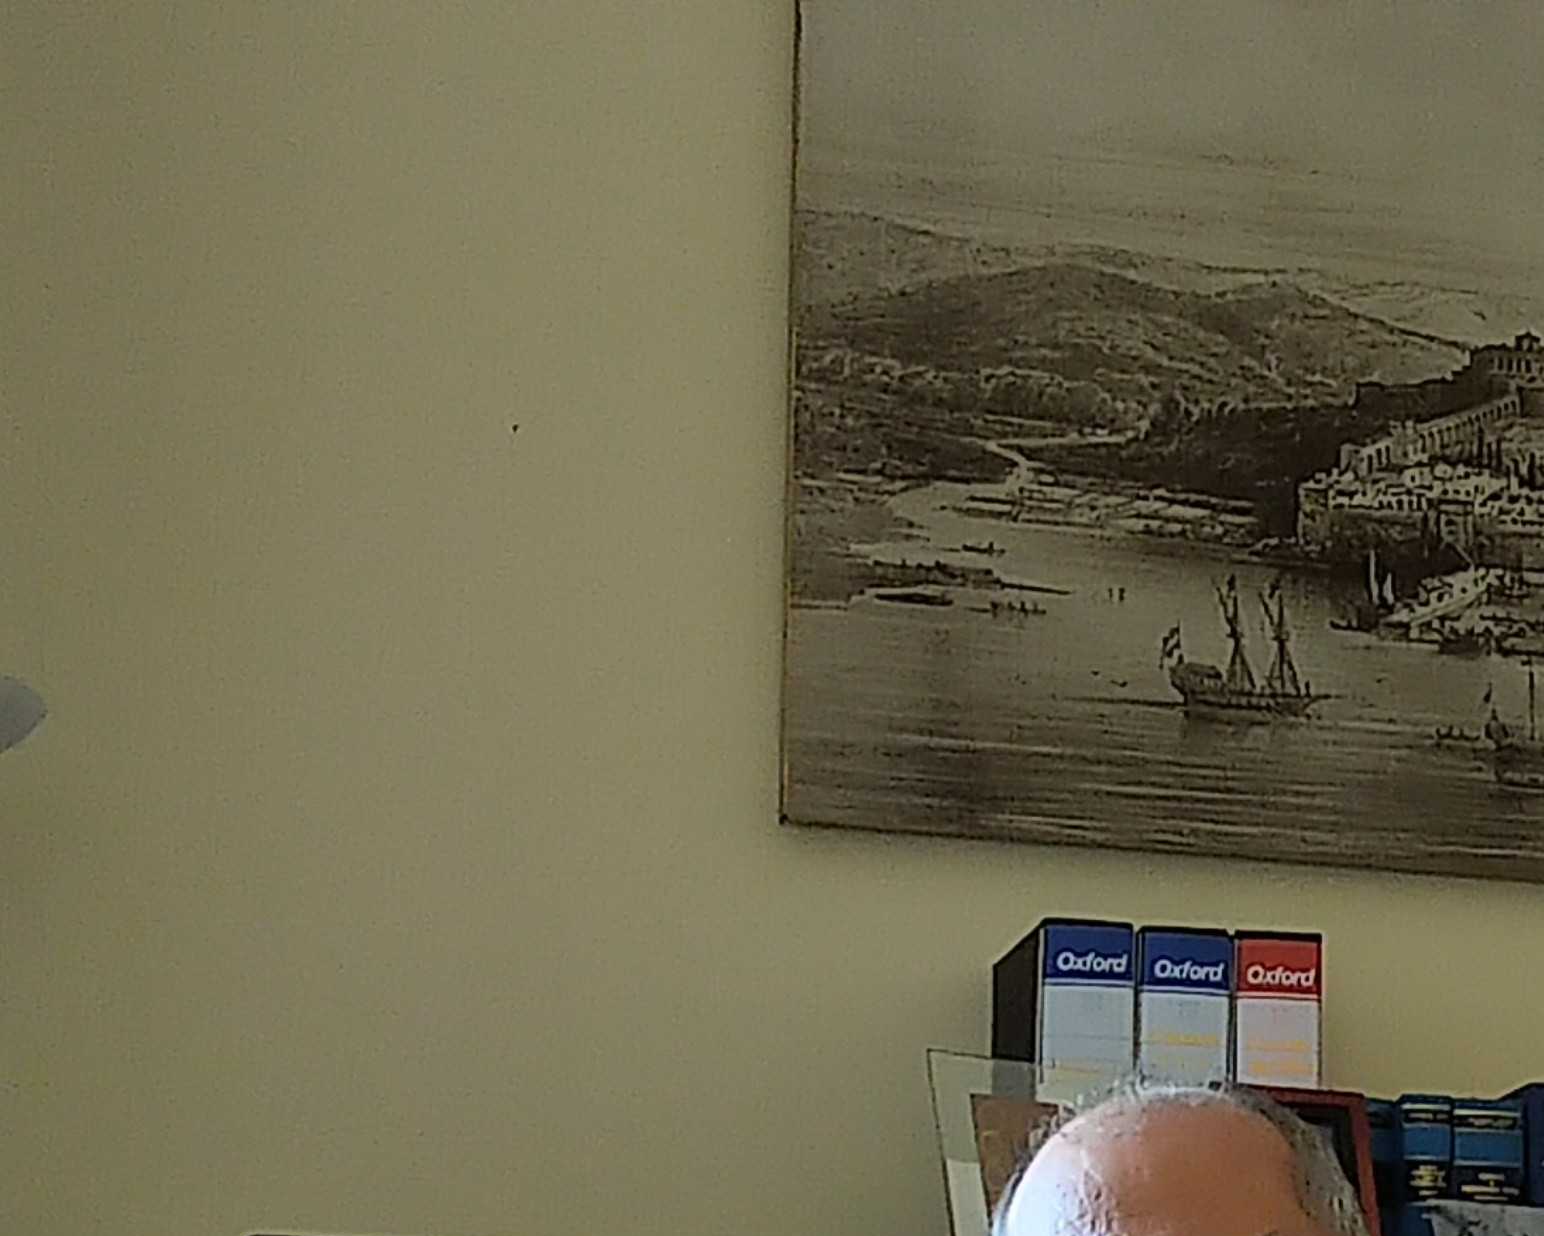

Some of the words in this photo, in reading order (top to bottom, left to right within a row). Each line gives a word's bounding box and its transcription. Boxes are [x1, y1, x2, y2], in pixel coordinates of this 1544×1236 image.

[1056, 951, 1128, 973] Oxford
[1154, 959, 1224, 982] Oxford
[1246, 966, 1316, 988] Oxford
